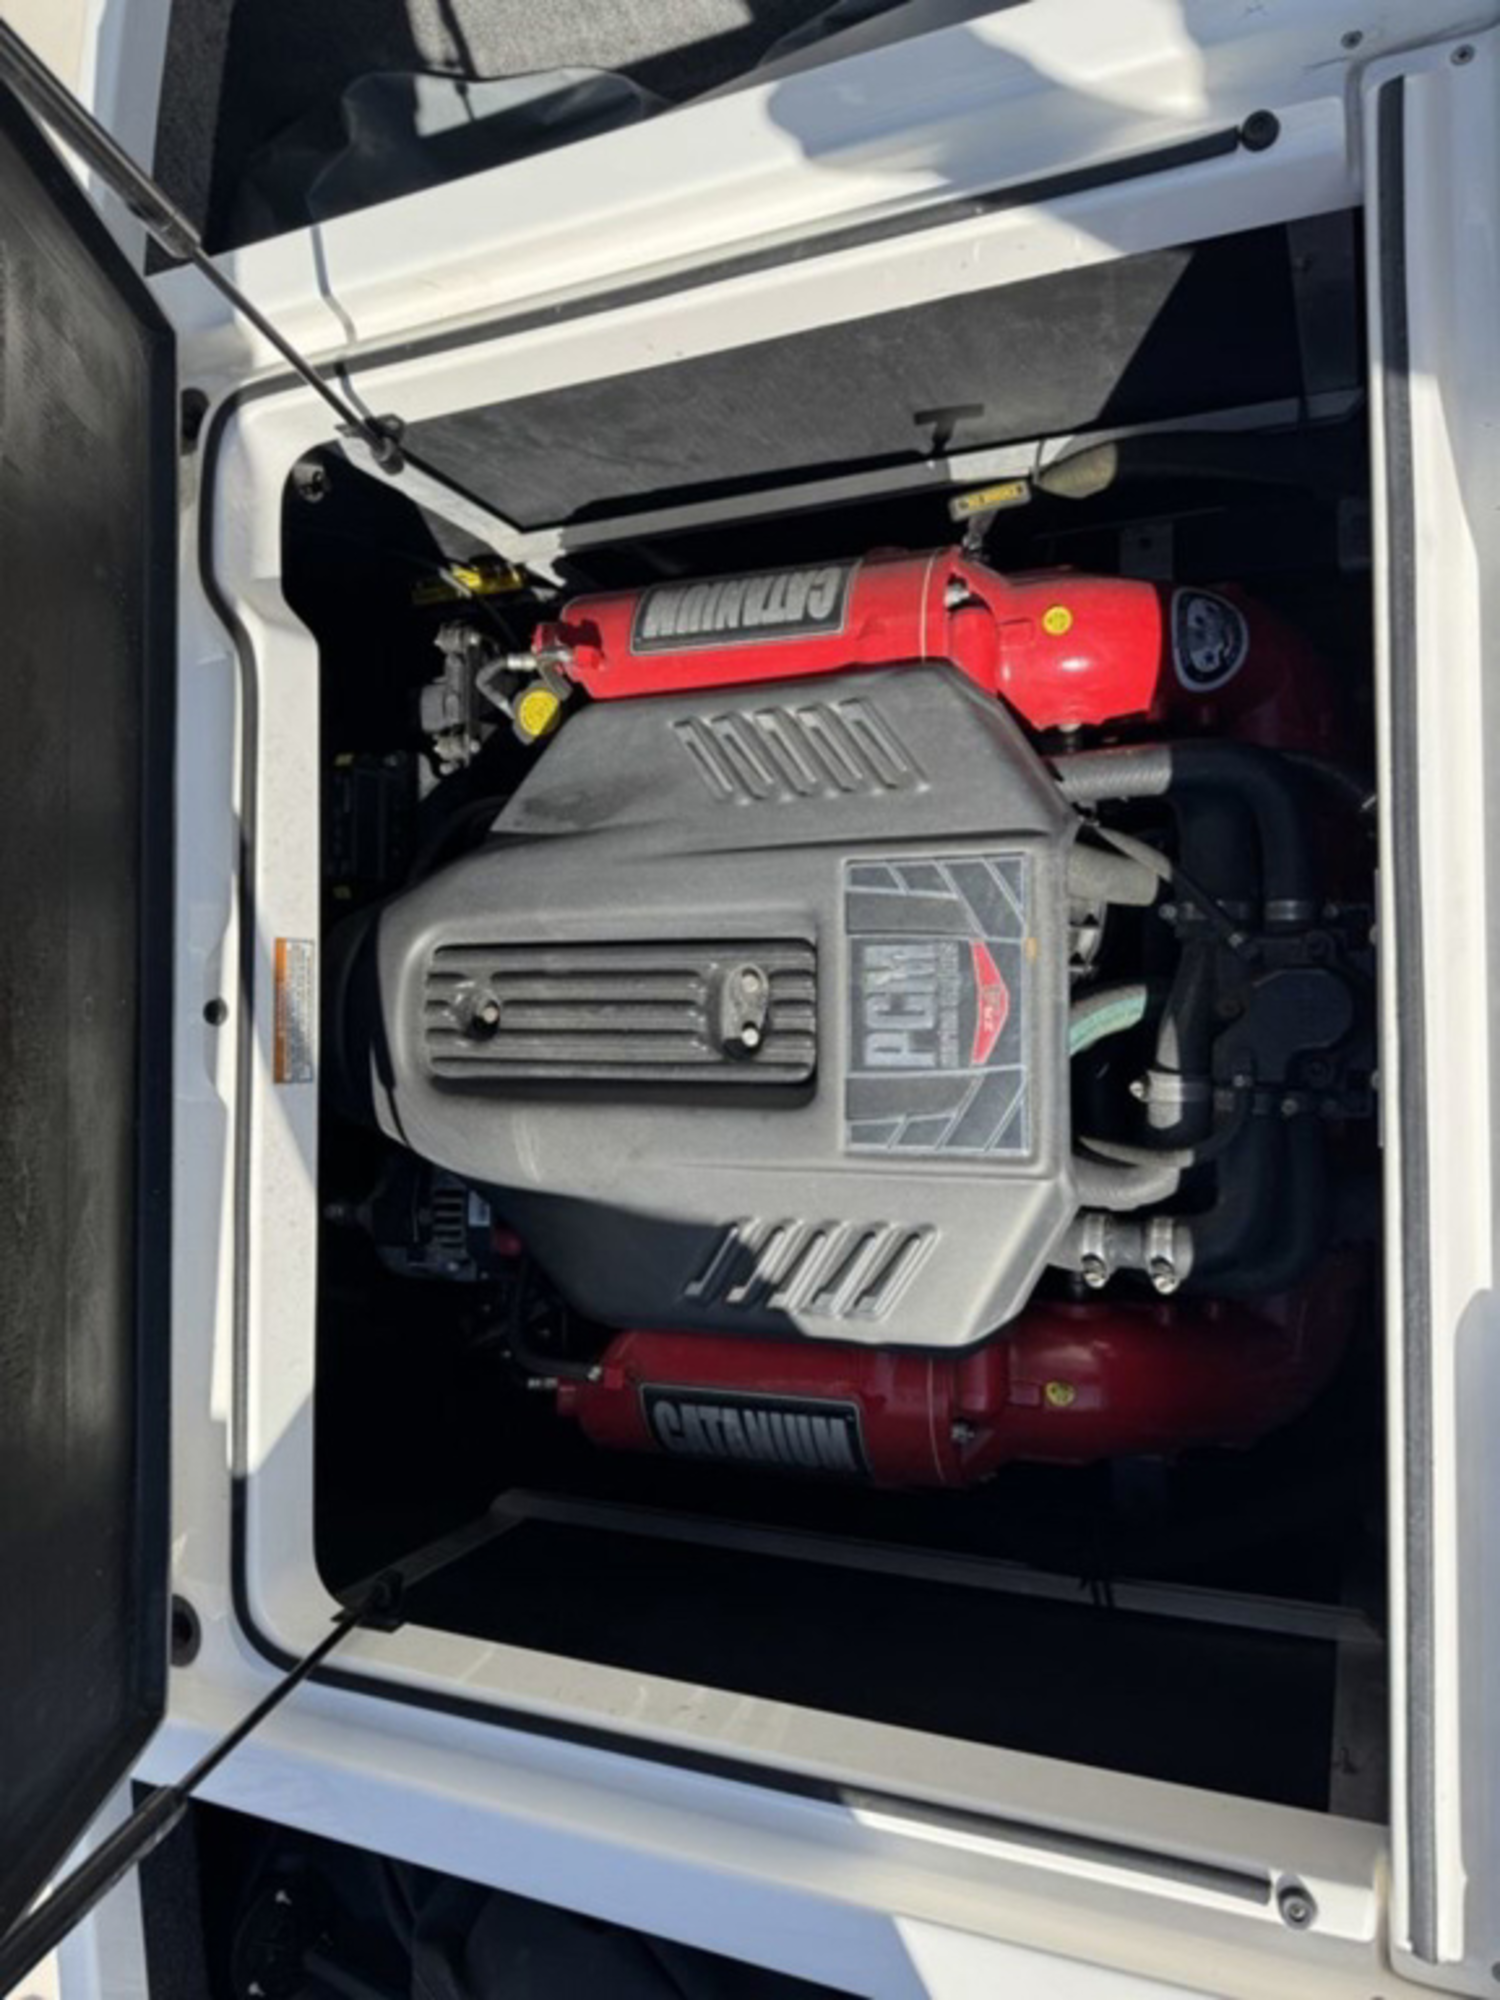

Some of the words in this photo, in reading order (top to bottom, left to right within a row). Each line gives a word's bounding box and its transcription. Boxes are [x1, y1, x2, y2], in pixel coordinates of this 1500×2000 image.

[643, 567, 842, 638] CATANIUM
[864, 945, 936, 1066] PCM
[652, 1400, 858, 1473] CATANIUM
